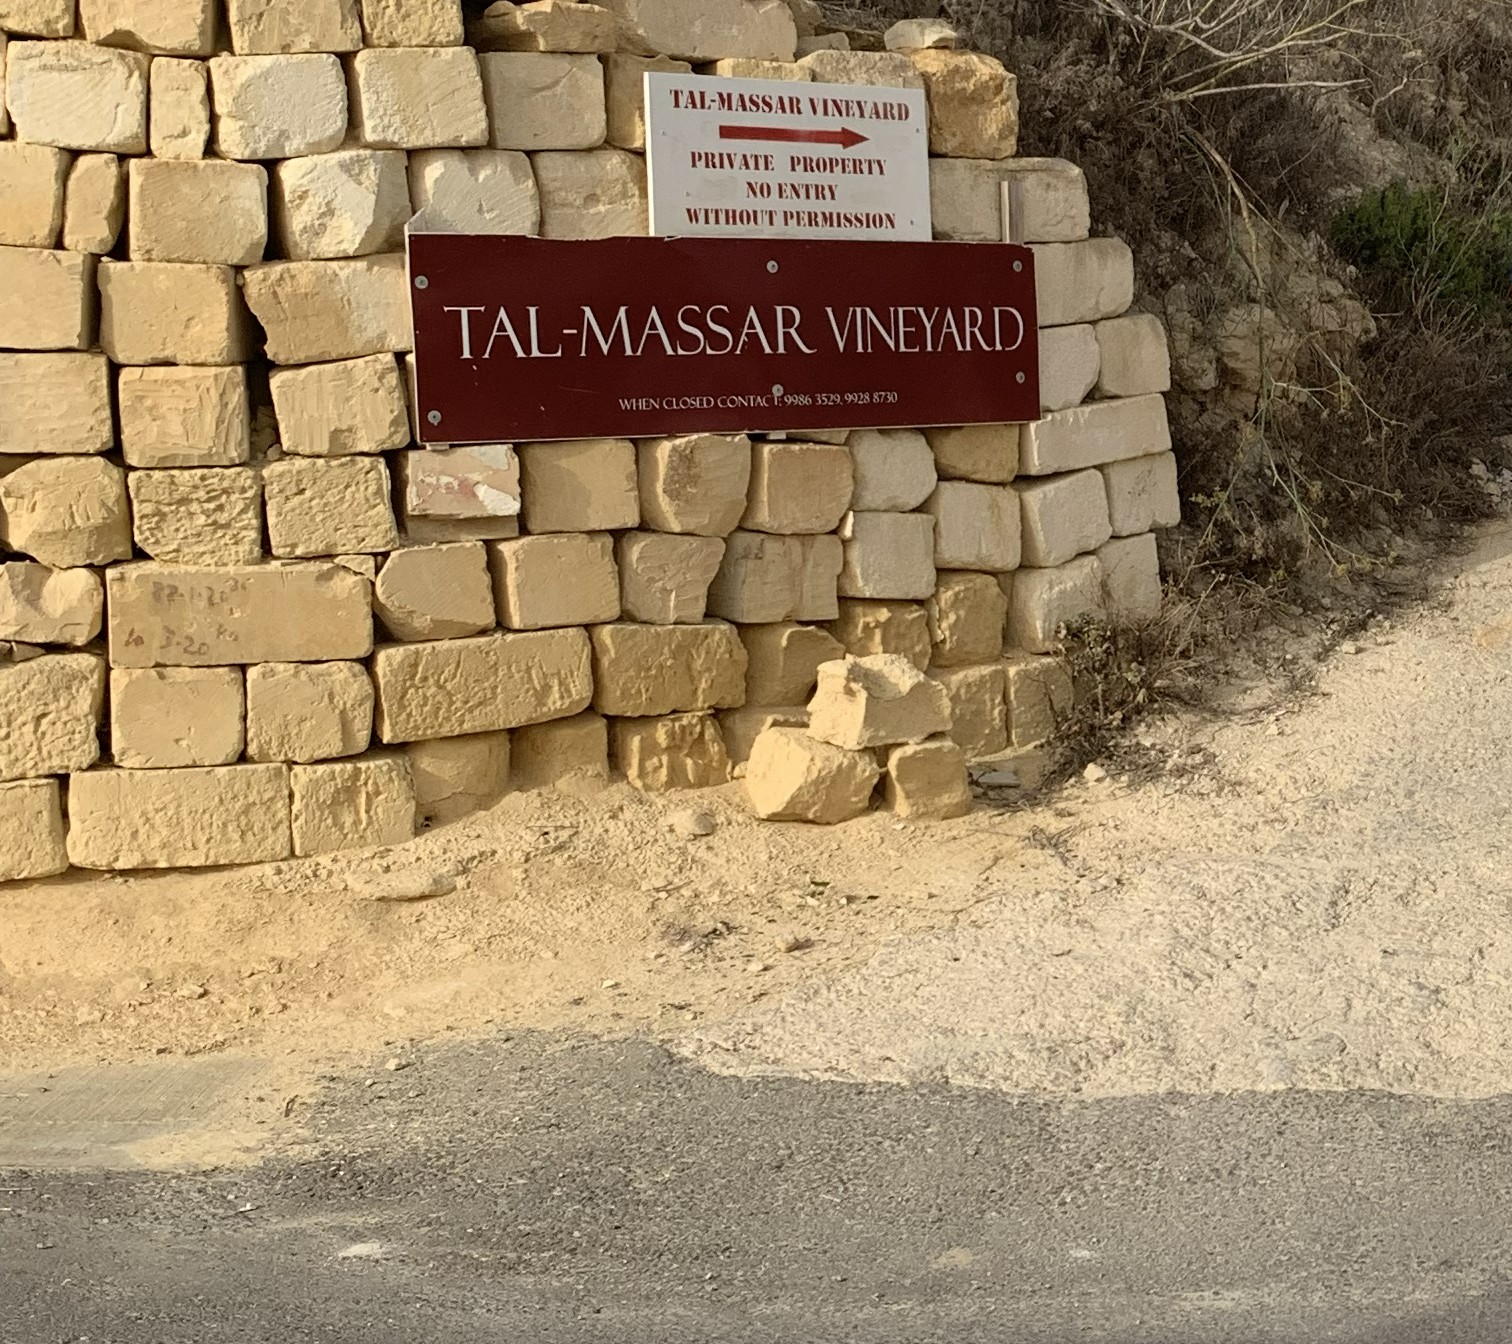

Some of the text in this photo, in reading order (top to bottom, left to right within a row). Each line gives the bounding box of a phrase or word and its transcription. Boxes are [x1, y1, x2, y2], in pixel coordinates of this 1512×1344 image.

[670, 89, 910, 121] TAL-MASSAR VINEYARD
[690, 151, 886, 176] PRIVATE PROPERTY
[746, 181, 838, 201] NO ENTRY
[686, 207, 896, 229] WITHOUT PERMISSION
[443, 303, 1024, 360] TAL-MASSAR VINEYARD
[618, 397, 660, 411] WHEN
[662, 396, 715, 410] CLOSED
[783, 394, 813, 406] 9986
[844, 391, 871, 405] 9928
[872, 391, 898, 404] 8730
